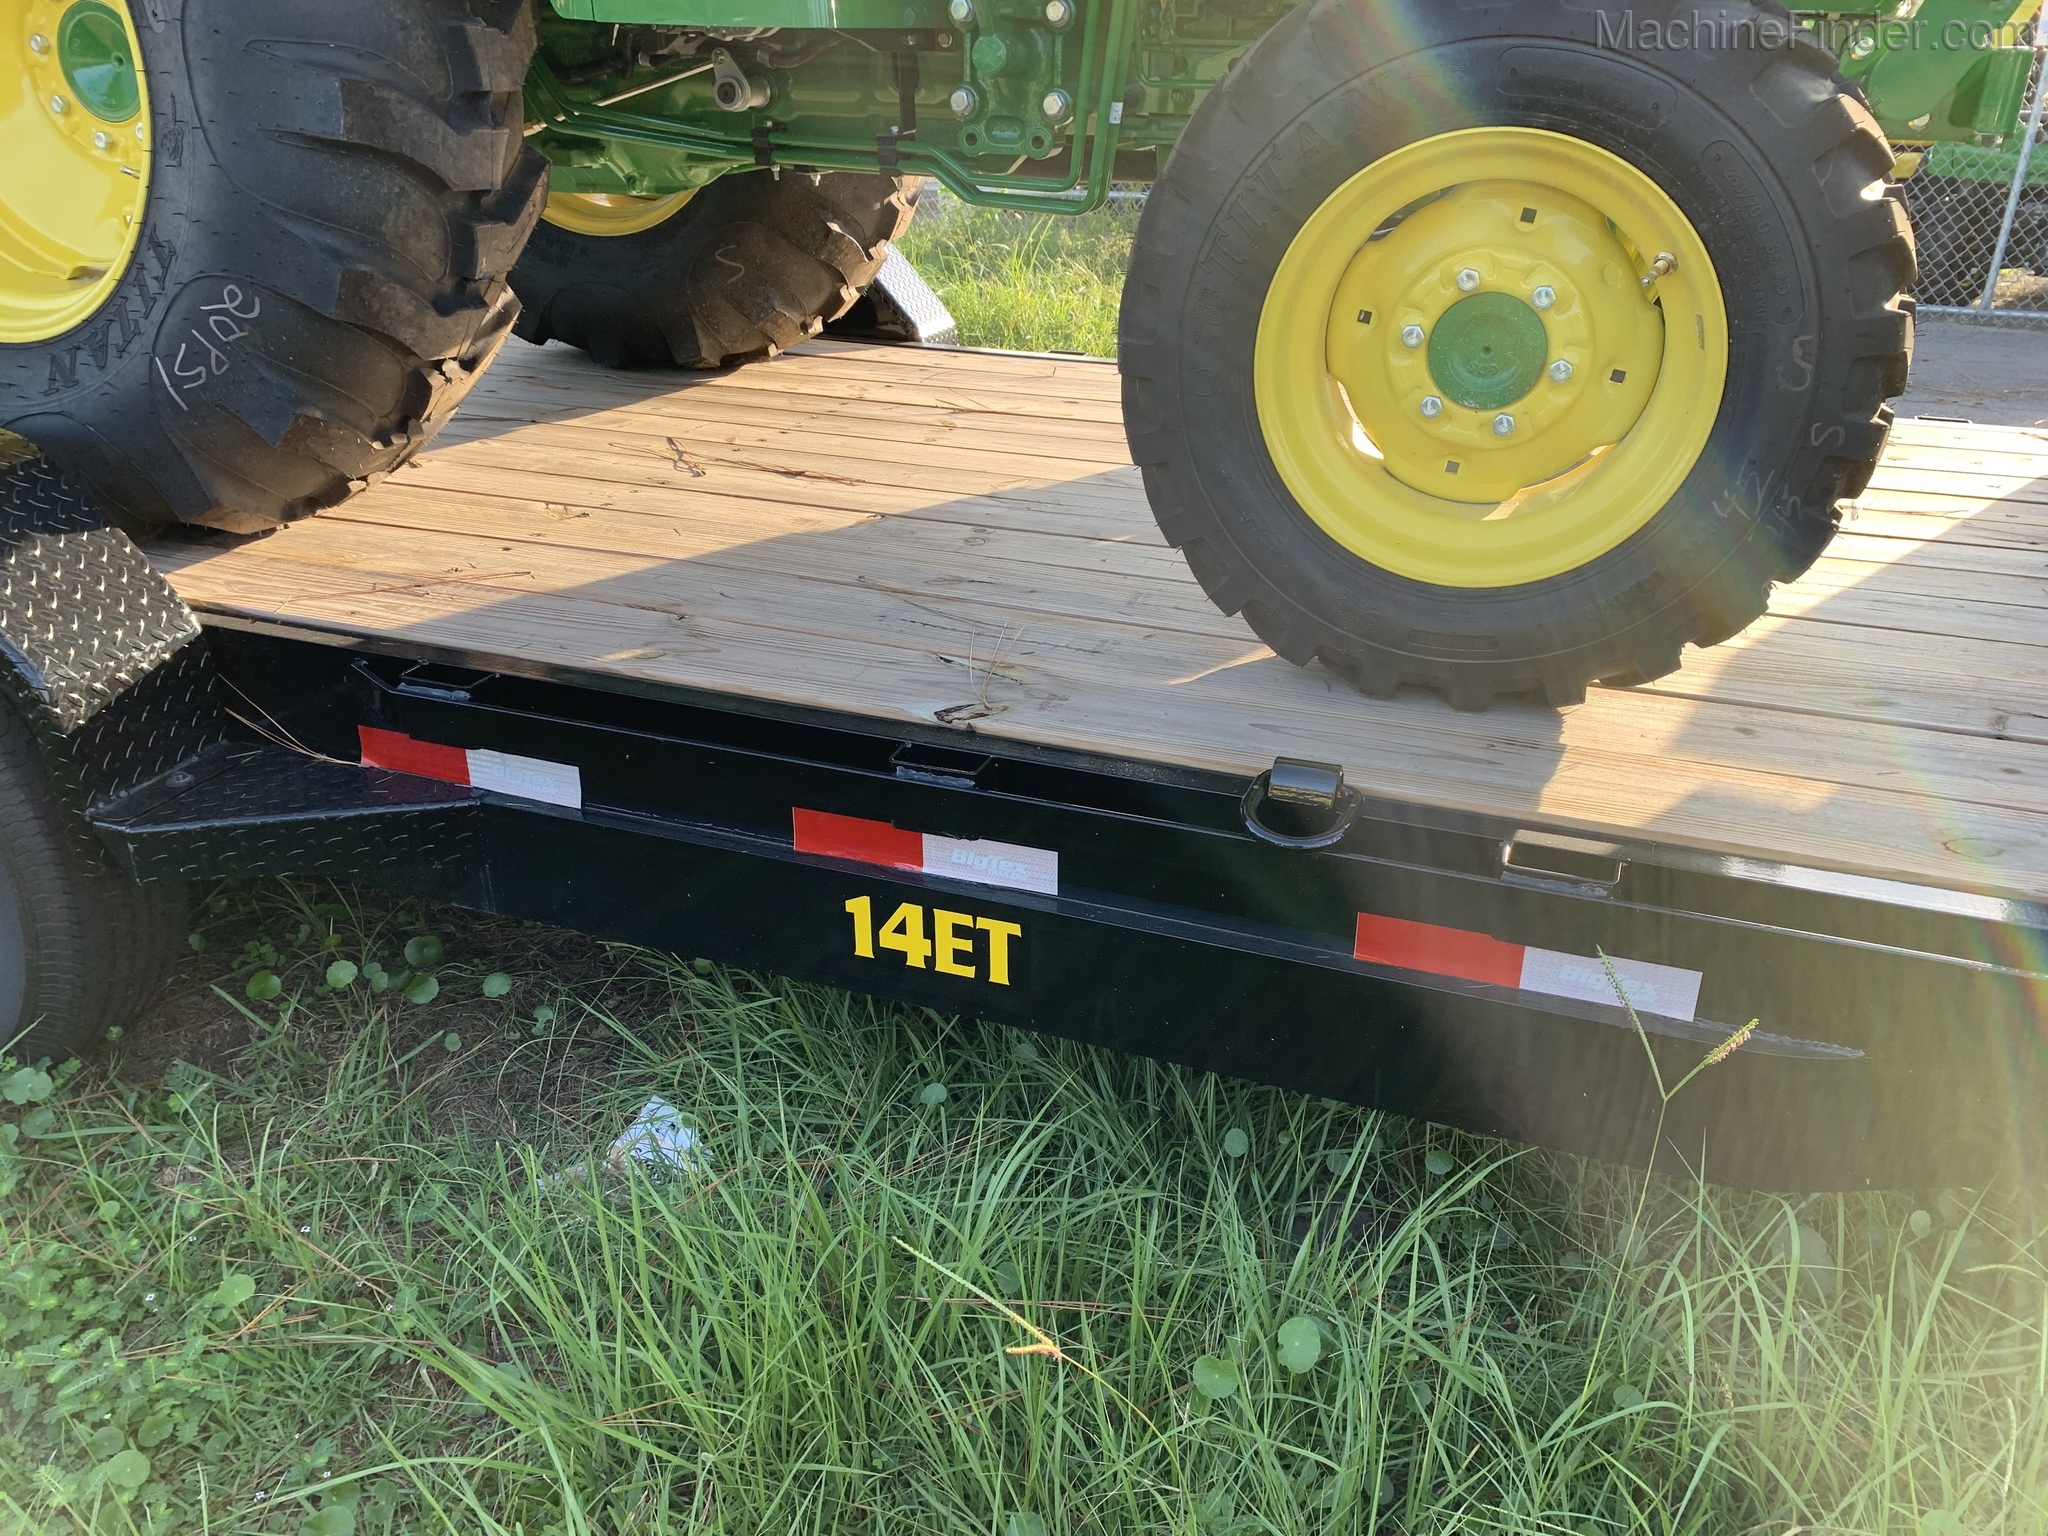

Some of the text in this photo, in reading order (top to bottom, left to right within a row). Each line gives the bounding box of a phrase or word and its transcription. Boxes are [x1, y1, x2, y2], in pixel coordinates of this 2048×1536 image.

[39, 222, 177, 397] TITAN
[951, 849, 1028, 874] BigTex
[988, 869, 1027, 881] TRAILERS
[845, 895, 1022, 985] 14ET
